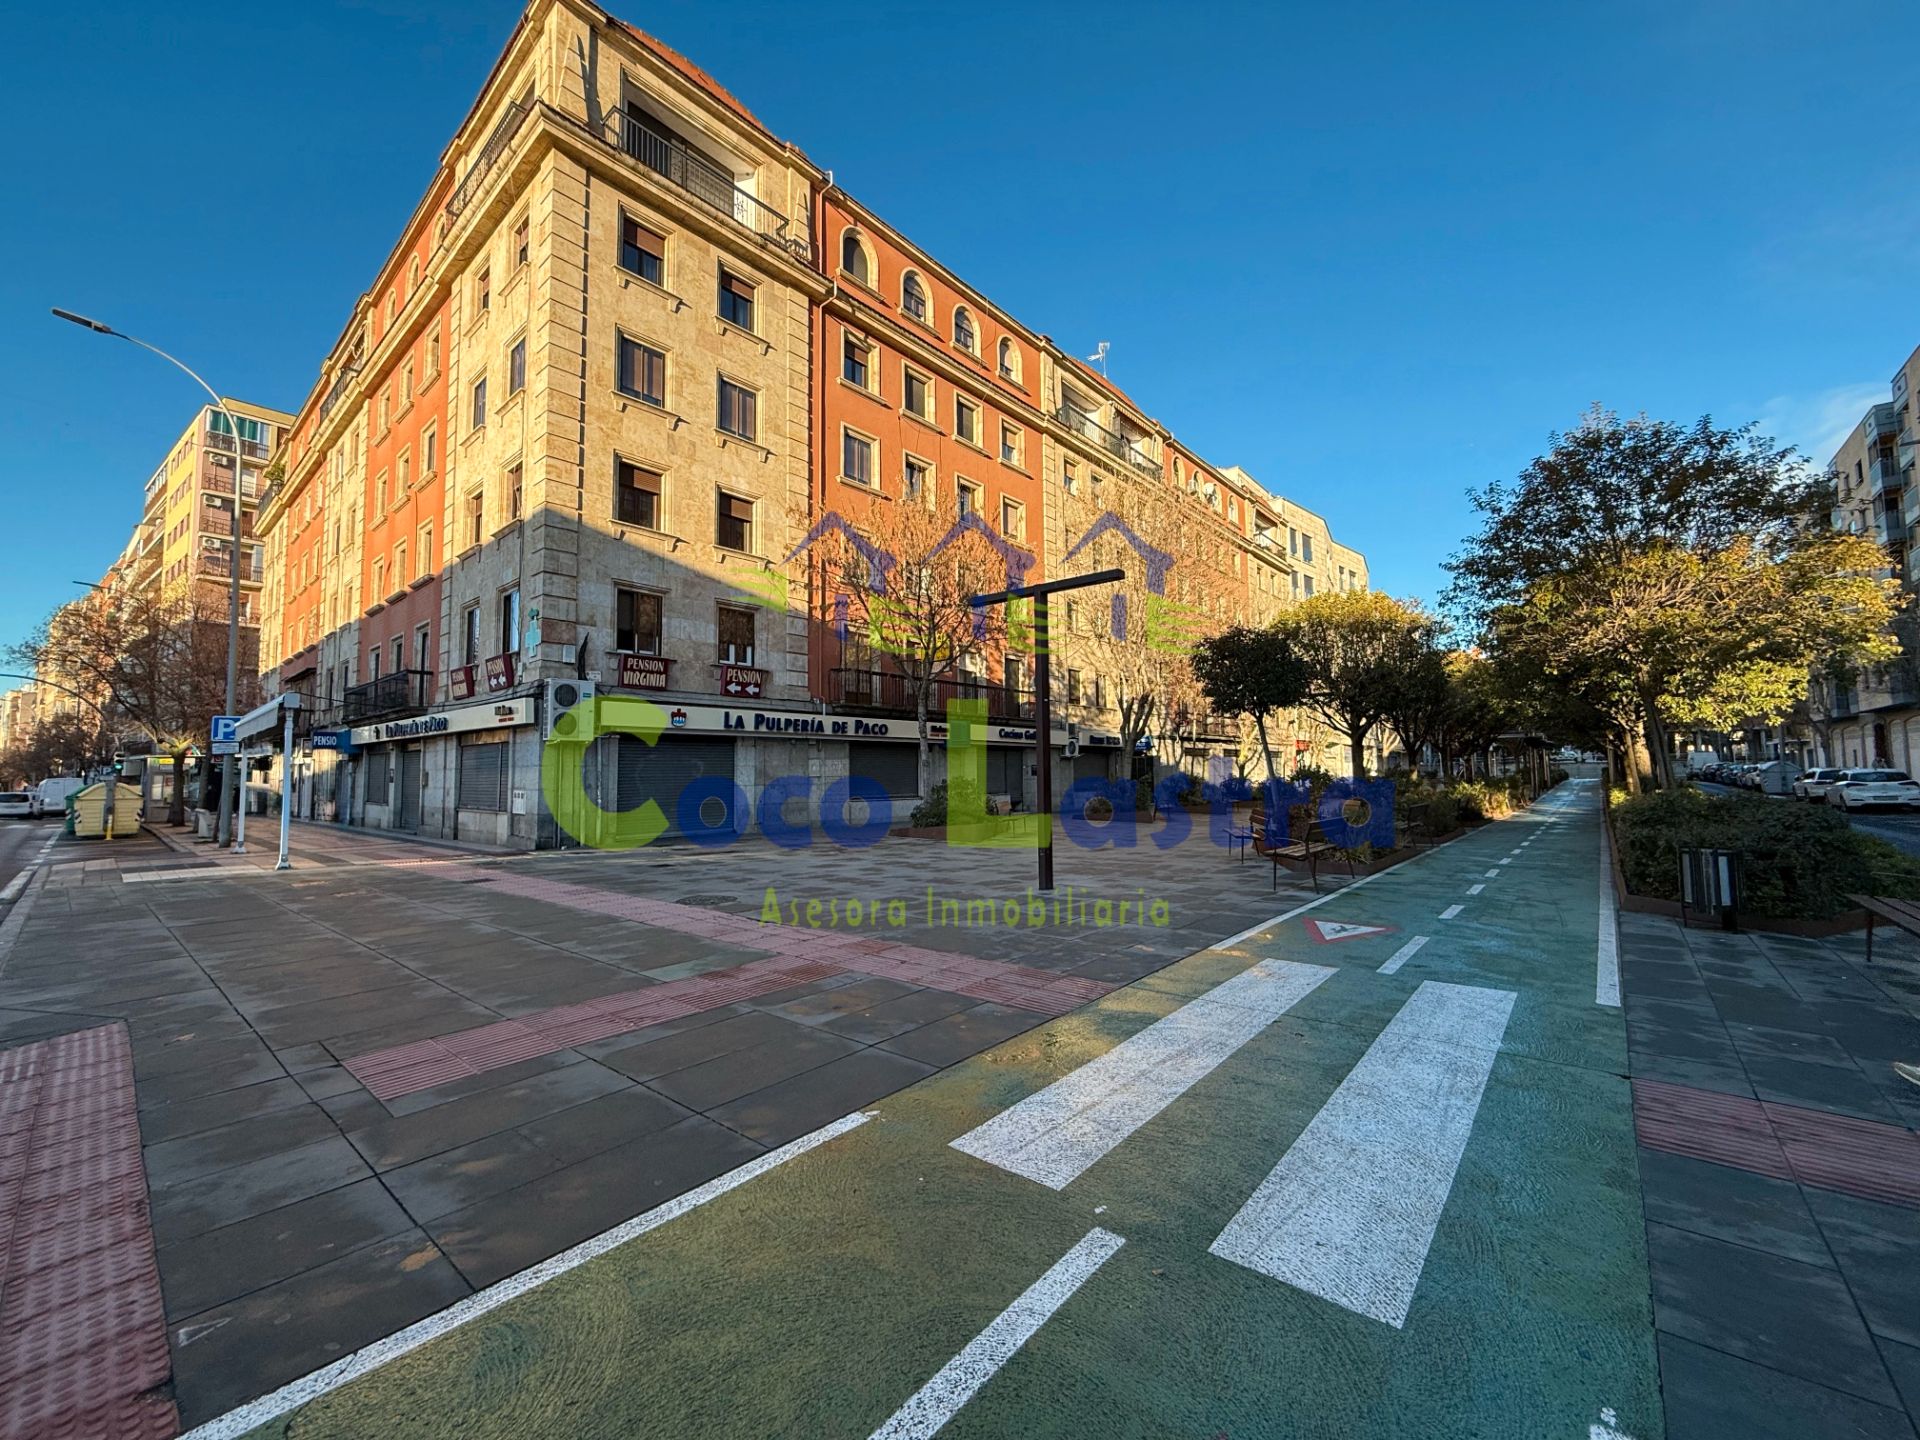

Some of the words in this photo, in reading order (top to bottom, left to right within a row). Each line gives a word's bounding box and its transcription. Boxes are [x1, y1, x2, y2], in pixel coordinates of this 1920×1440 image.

[626, 657, 665, 672] PENSION
[623, 670, 666, 688] VIRGINIA
[726, 668, 762, 684] PENSION
[214, 718, 237, 740] P
[723, 711, 745, 730] LA
[753, 713, 825, 734] PULPERÍA
[831, 720, 848, 734] DE
[854, 719, 889, 735] PACO
